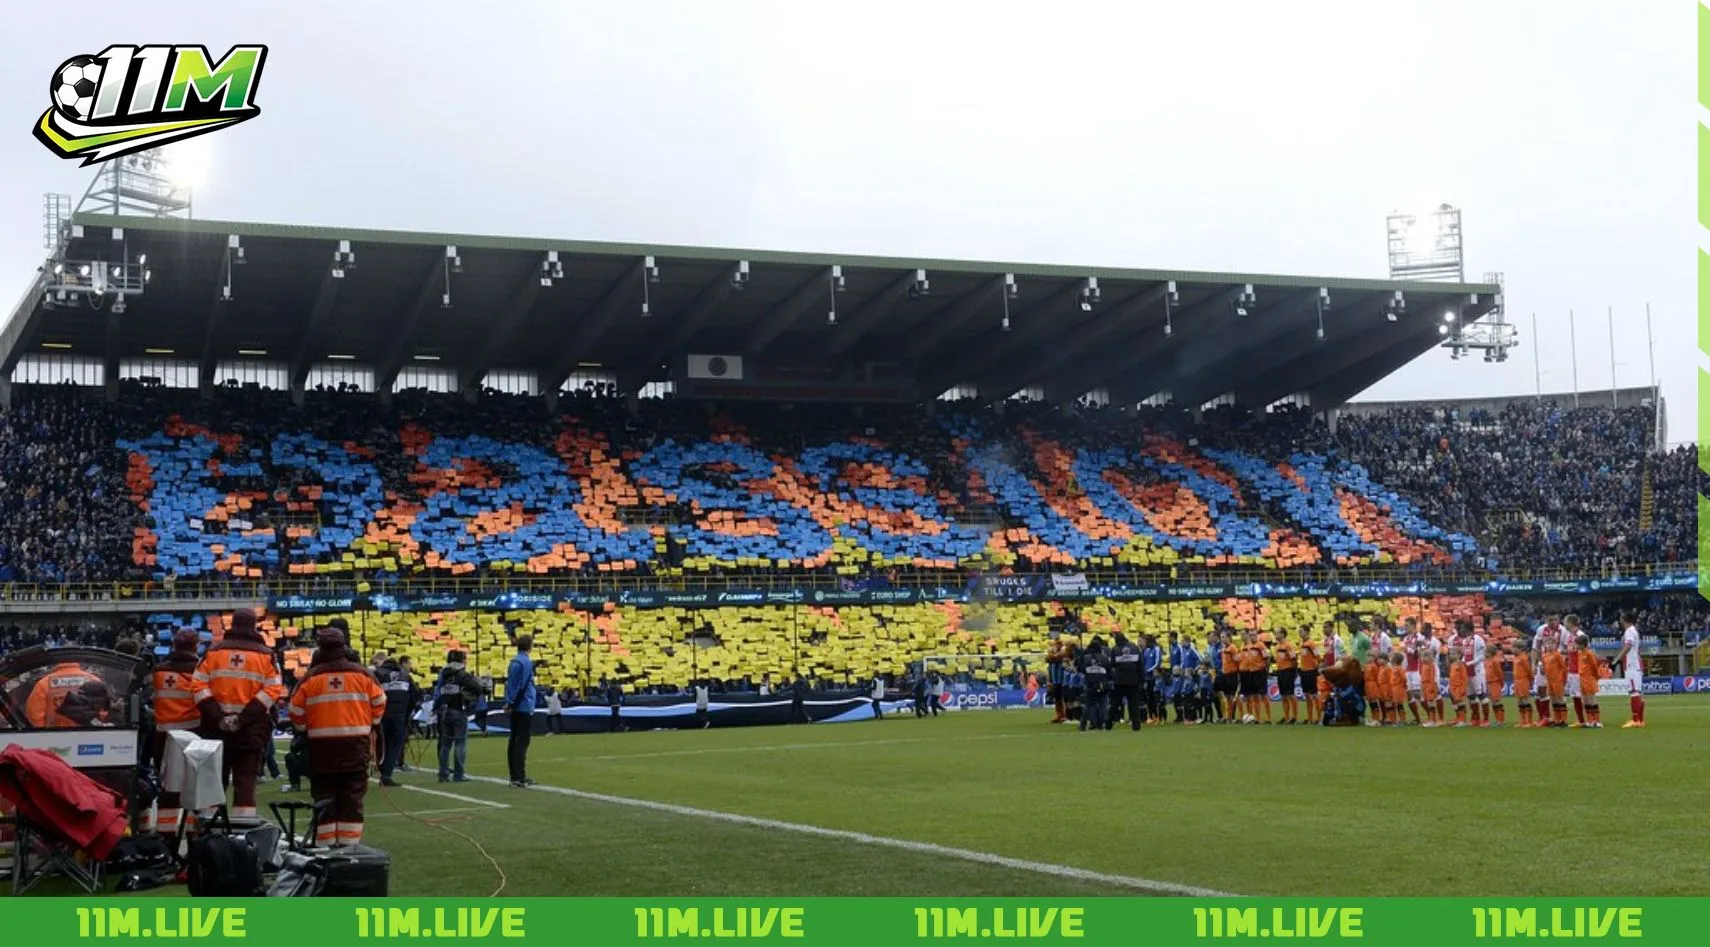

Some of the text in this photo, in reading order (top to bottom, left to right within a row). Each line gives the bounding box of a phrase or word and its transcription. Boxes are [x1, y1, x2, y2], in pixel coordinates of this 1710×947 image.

[983, 587, 1003, 596] TILL
[275, 600, 288, 608] NO
[315, 599, 327, 607] NO
[328, 599, 352, 607] GLORY
[957, 691, 998, 707] pepsi
